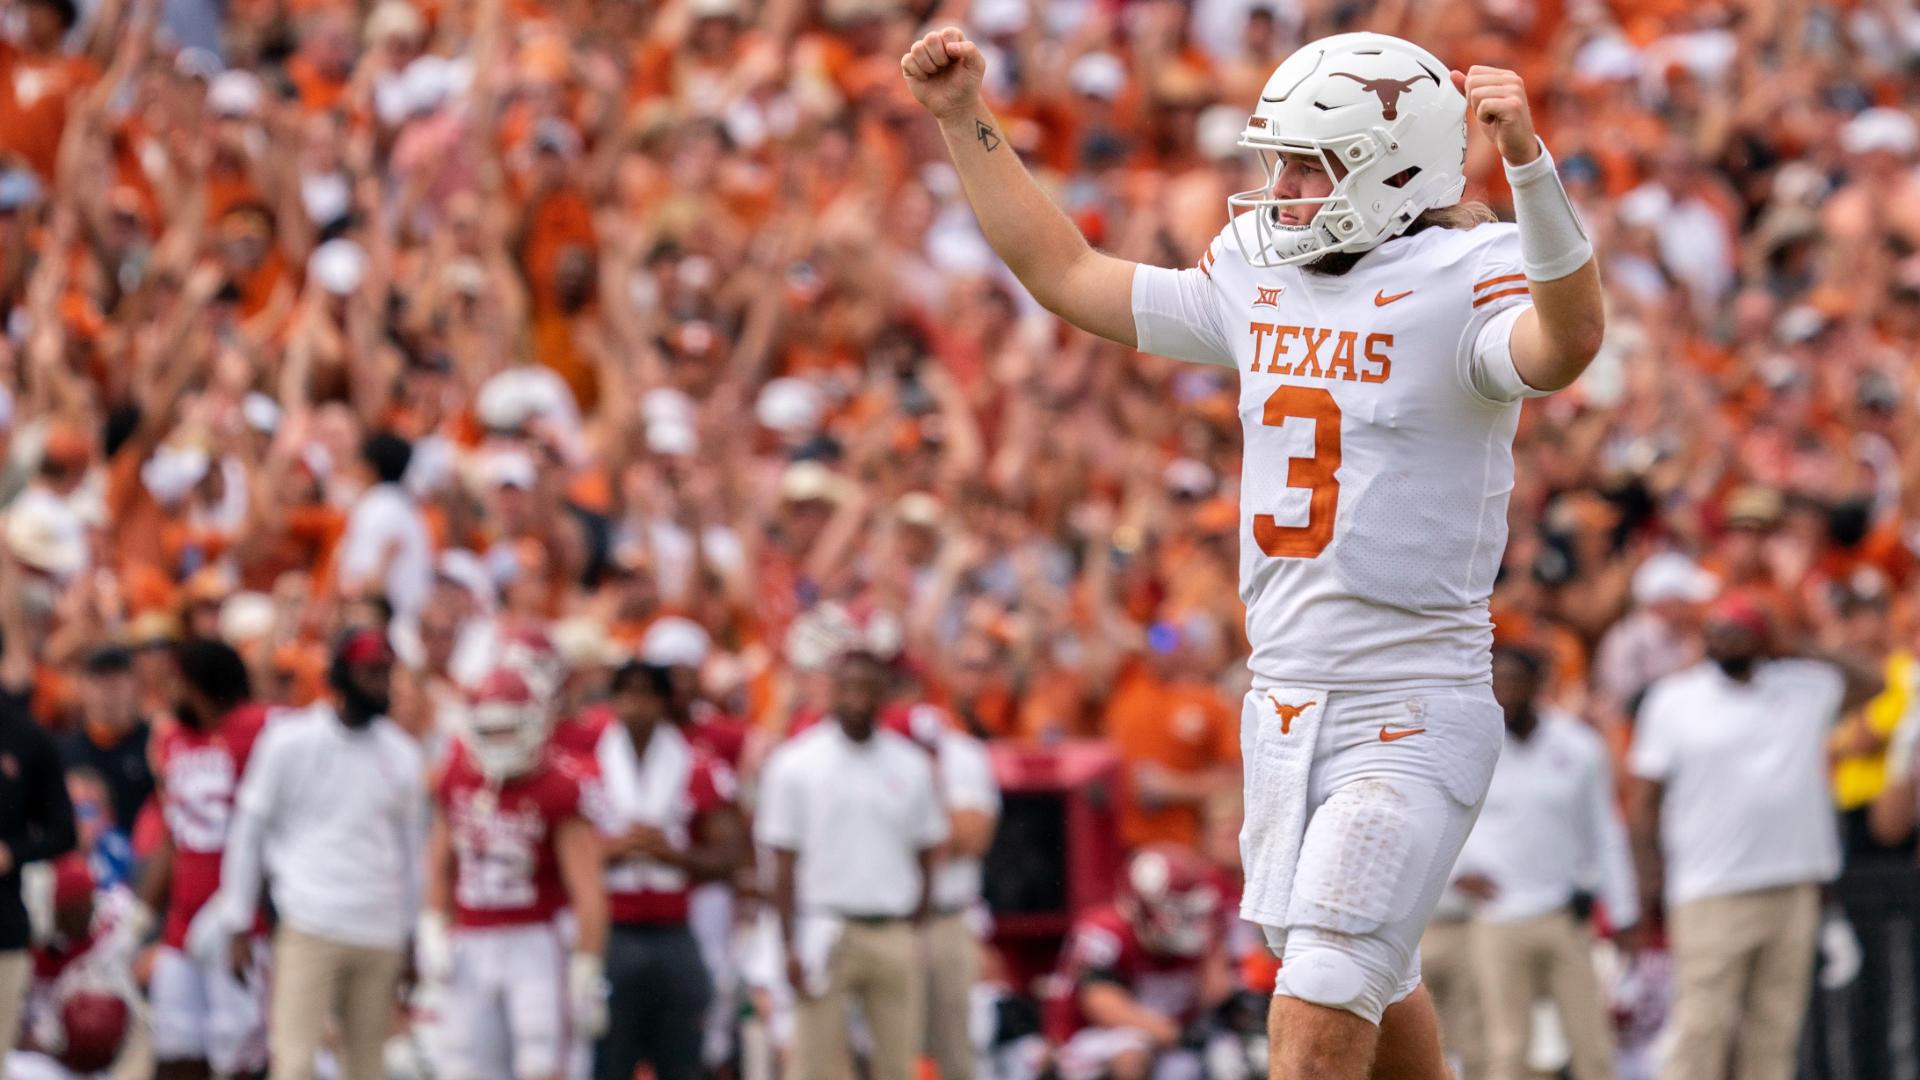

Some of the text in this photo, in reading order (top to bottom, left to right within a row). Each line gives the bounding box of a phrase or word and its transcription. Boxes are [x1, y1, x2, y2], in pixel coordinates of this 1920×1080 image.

[1253, 285, 1282, 307] XII
[1250, 321, 1394, 384] TEXAS
[1252, 384, 1342, 559] 3
